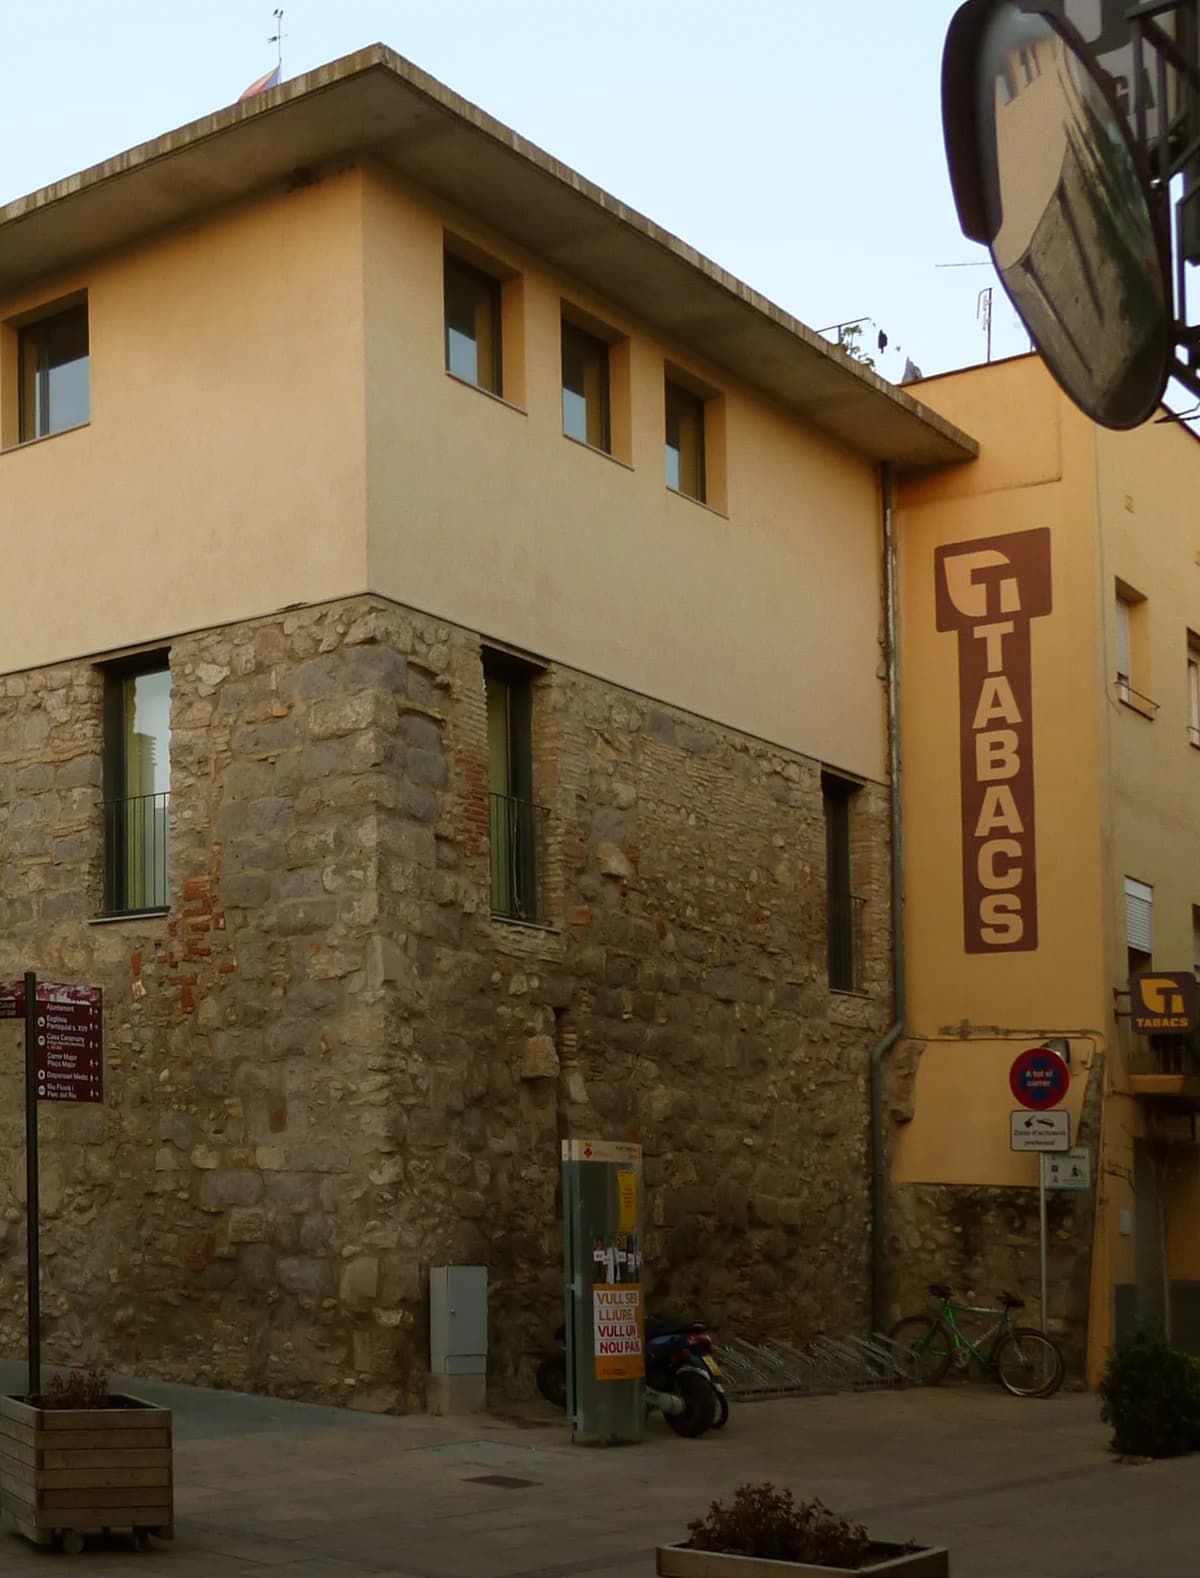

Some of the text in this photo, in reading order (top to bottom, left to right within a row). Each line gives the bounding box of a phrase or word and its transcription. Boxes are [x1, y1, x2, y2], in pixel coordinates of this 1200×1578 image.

[972, 620, 1025, 946] TABACS
[1136, 1017, 1189, 1028] TABACS
[1024, 1069, 1032, 1078] A
[1025, 1080, 1052, 1088] carrer
[597, 1292, 624, 1305] VULL
[598, 1325, 636, 1337] VULL UN
[599, 1341, 623, 1354] NOU
